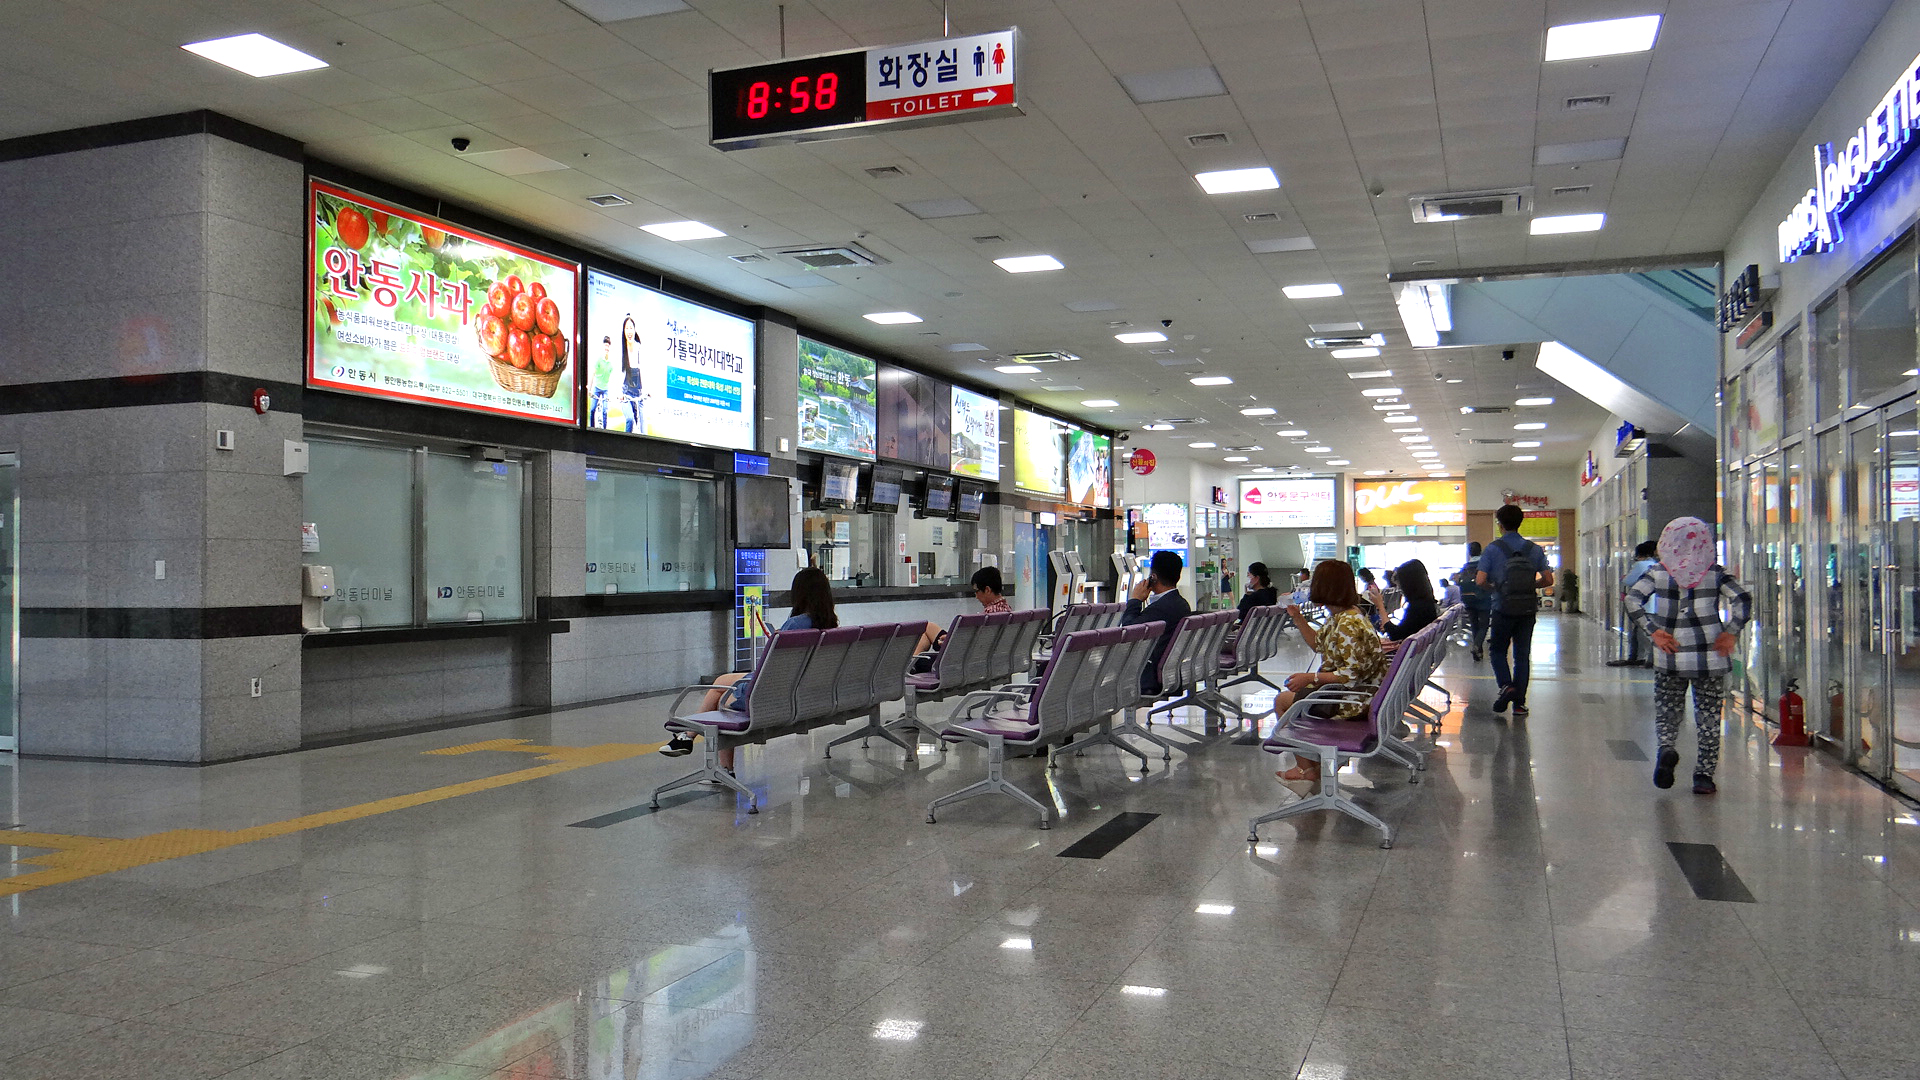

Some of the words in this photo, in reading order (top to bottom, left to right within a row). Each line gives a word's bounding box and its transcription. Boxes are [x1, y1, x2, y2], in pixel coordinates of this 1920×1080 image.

[878, 47, 958, 89] 화장실
[747, 73, 838, 119] 8:58
[891, 95, 962, 115] TOILET
[324, 248, 473, 326] 안동사과
[337, 330, 381, 348] 여성소비자가
[667, 337, 743, 374] 가톨릭상지대학교
[347, 368, 376, 382] 안동시
[838, 371, 851, 388] 안동
[1355, 481, 1423, 514] DUC
[599, 562, 636, 573] 안동터미널
[336, 587, 393, 602] 안동터미널
[456, 585, 505, 599] 안동터미널
